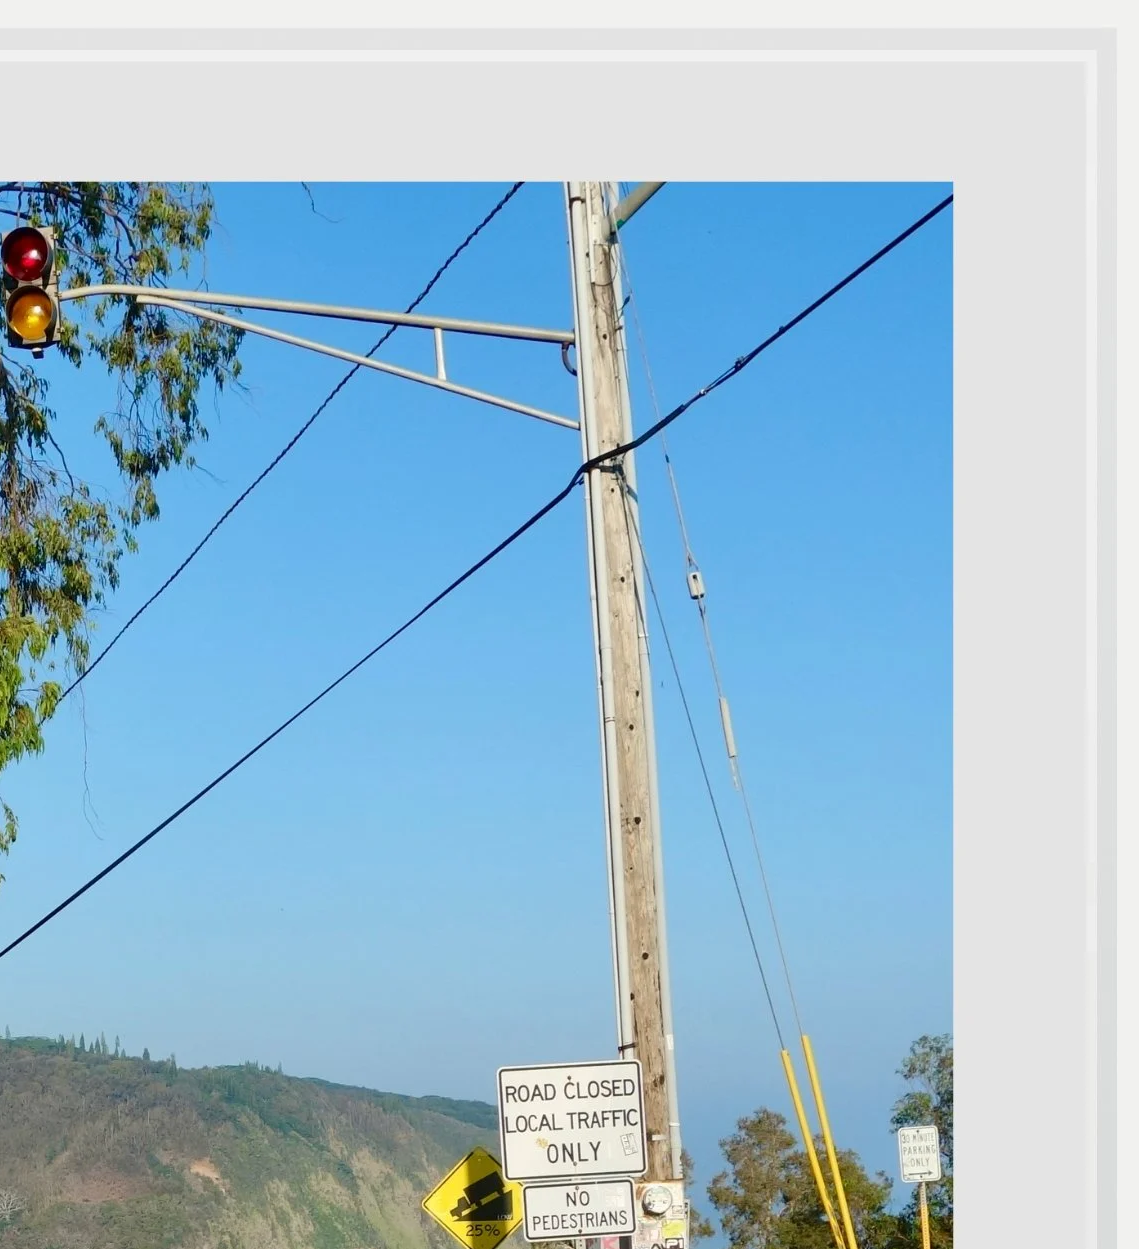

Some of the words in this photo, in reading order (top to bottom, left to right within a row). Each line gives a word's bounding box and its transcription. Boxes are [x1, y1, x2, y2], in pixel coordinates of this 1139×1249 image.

[505, 1083, 556, 1103] ROAD
[564, 1079, 635, 1099] CLOSED
[505, 1113, 563, 1133] LOCAL
[566, 1108, 639, 1130] TRAFFIC
[546, 1140, 601, 1164] ONLY
[902, 1145, 936, 1155] PARKING
[910, 1157, 930, 1168] ONLY
[566, 1190, 590, 1207] NO
[465, 1223, 501, 1237] 25%
[532, 1210, 628, 1232] PEDESTRIANS
